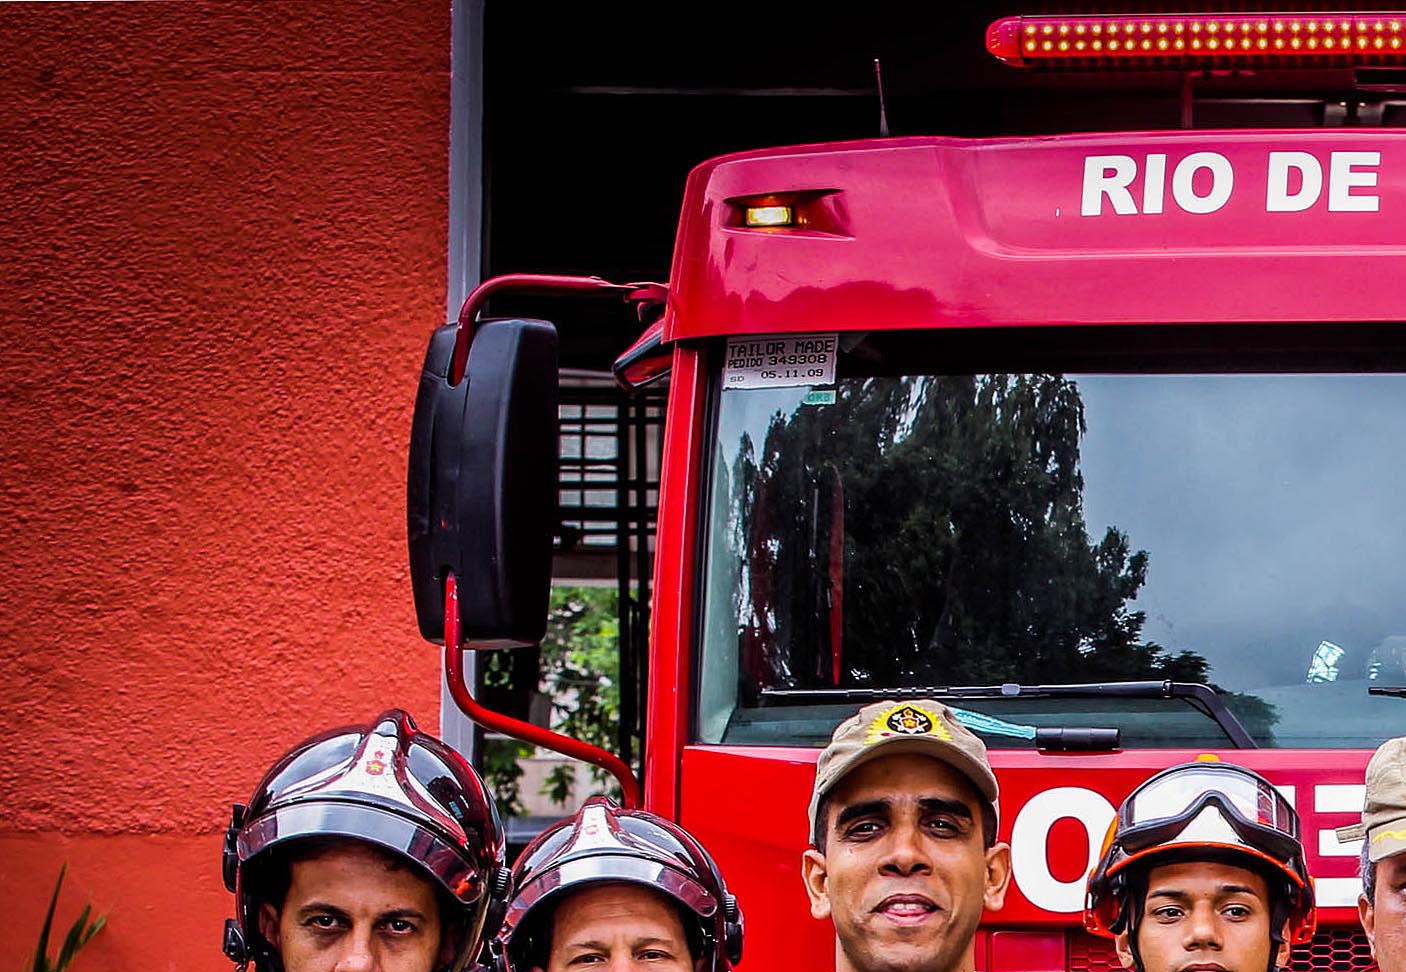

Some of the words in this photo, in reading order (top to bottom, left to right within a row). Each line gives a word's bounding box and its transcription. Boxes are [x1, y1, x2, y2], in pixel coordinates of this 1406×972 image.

[1080, 151, 1235, 217] RIO
[1265, 151, 1382, 213] DE
[729, 342, 786, 358] TAILOR
[794, 340, 834, 354] MADE
[728, 357, 763, 369] PEDIDO
[768, 354, 828, 366] 349308
[760, 368, 824, 380] 05.11.09
